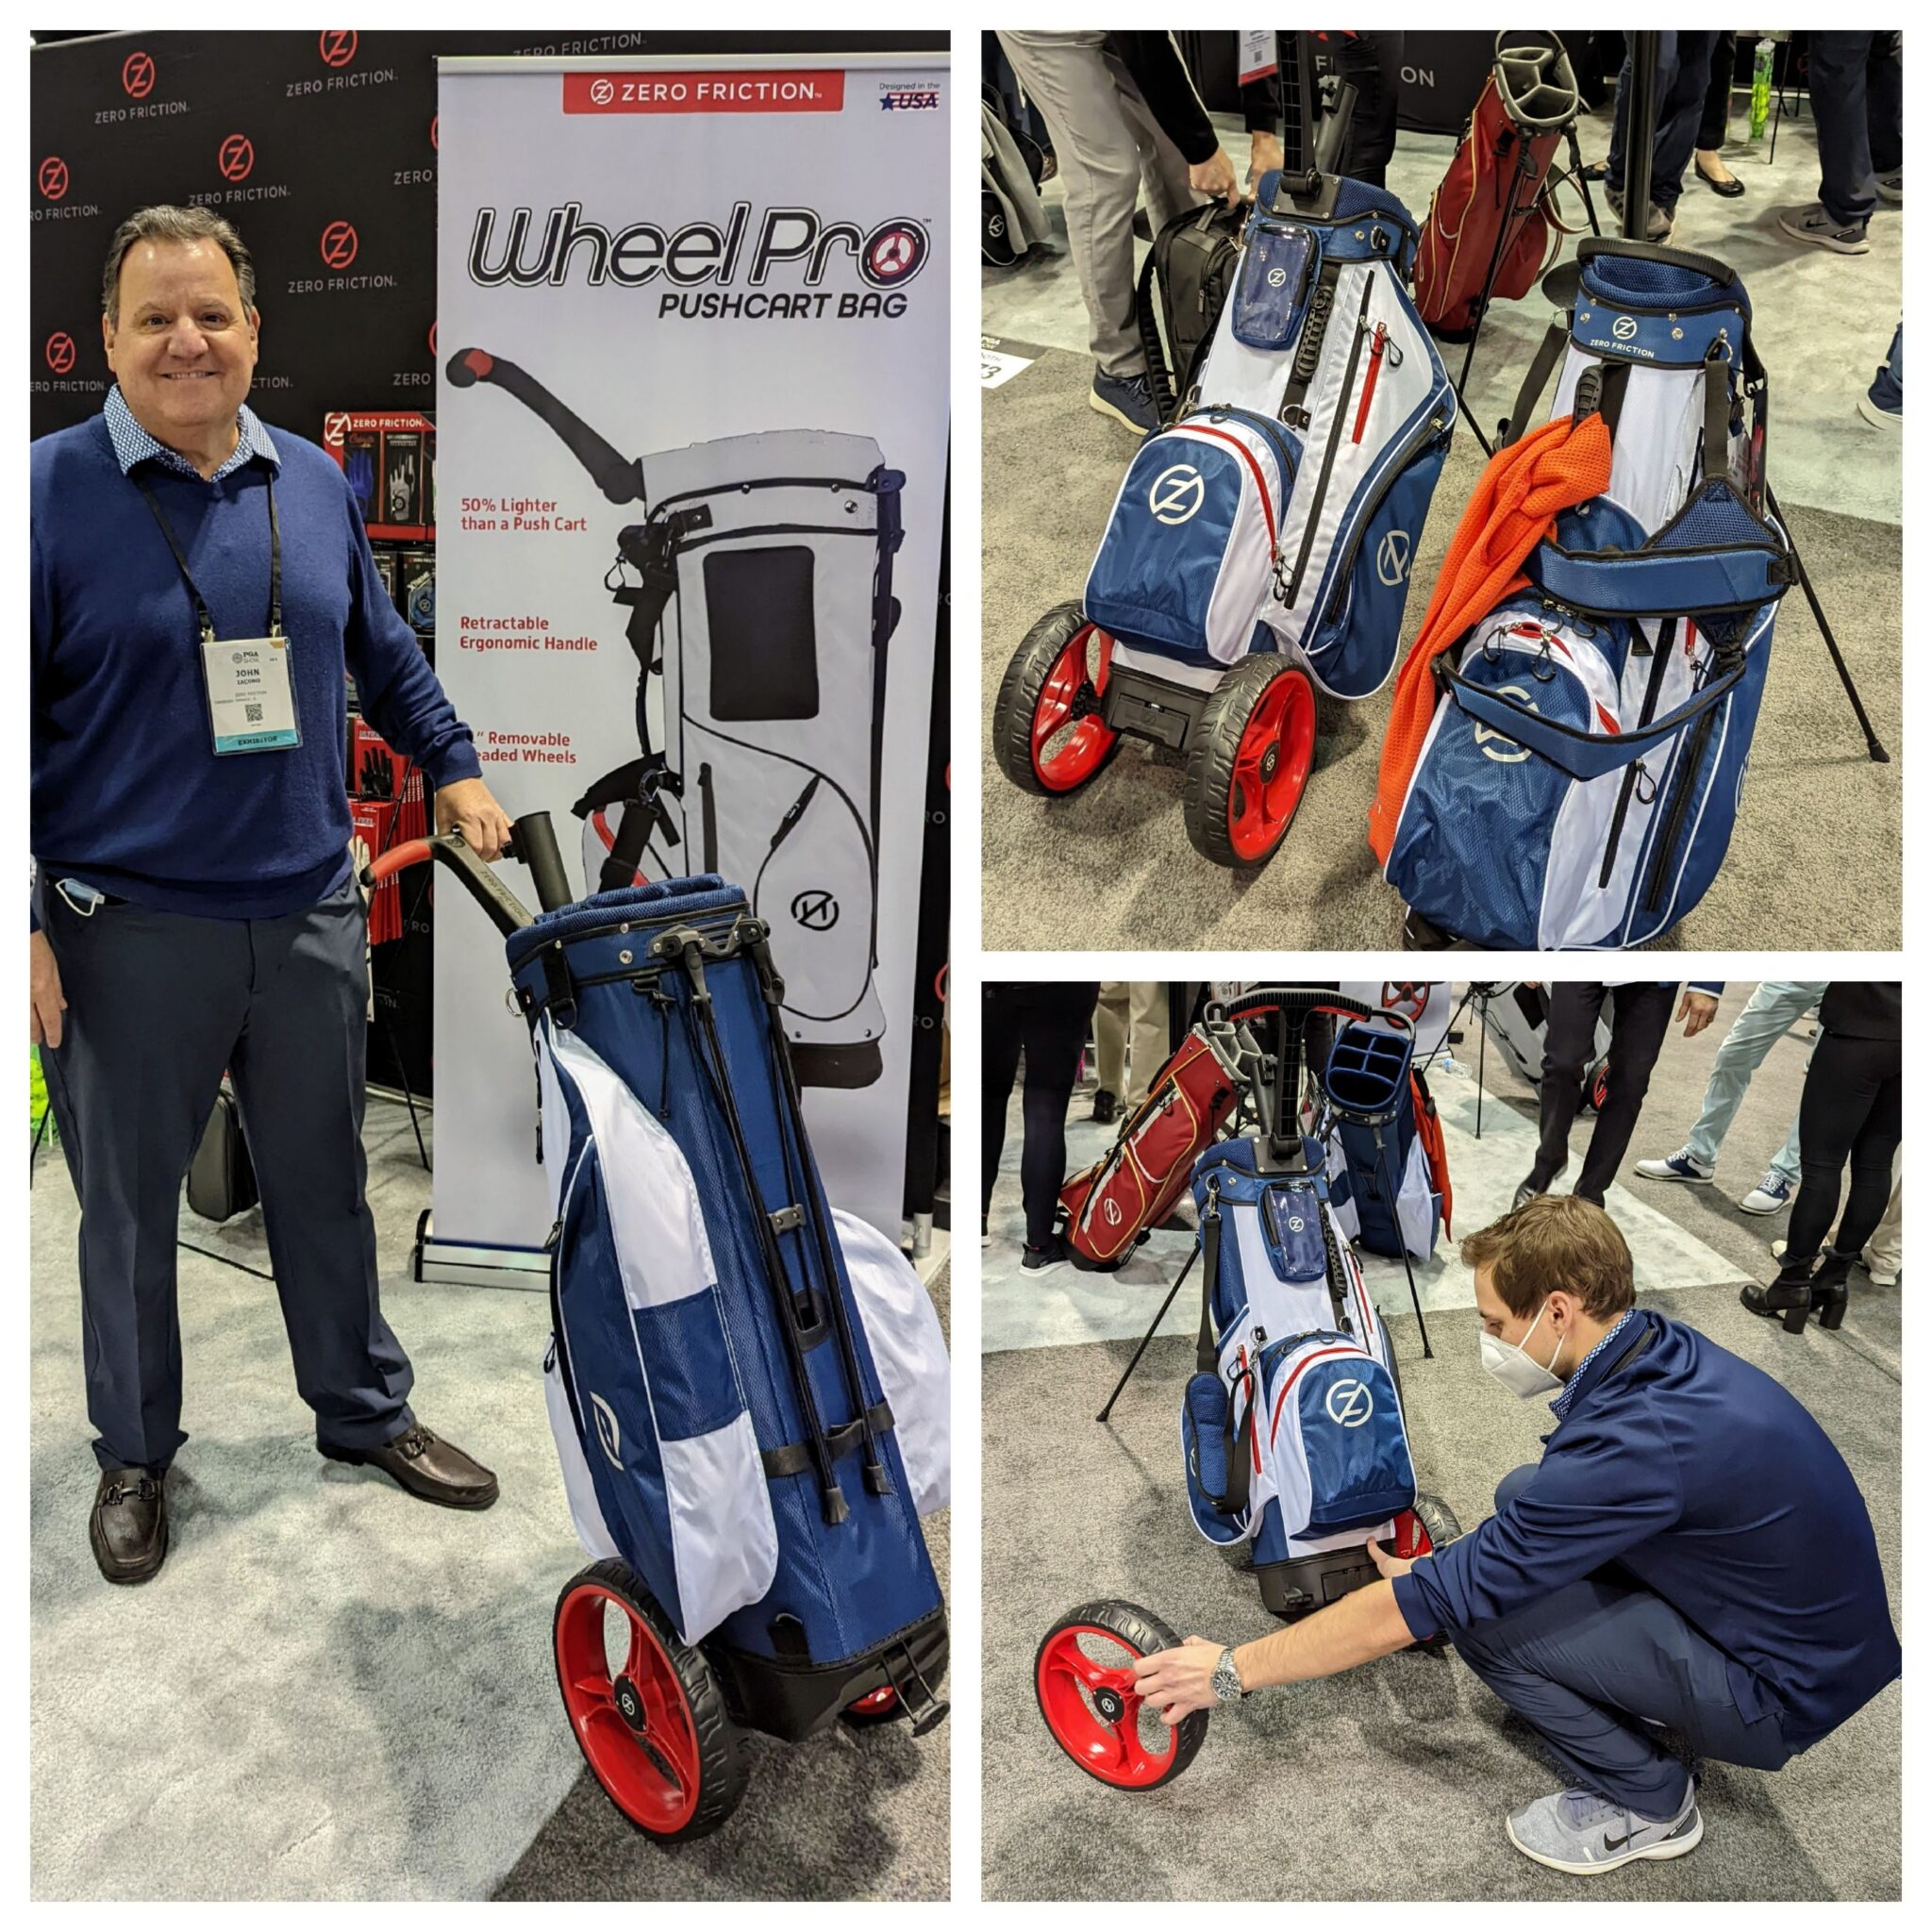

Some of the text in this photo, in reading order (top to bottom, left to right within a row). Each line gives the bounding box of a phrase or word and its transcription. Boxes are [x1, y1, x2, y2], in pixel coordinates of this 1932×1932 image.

[286, 69, 394, 97] ZERO FRICTION
[879, 82, 916, 91] Designed
[621, 83, 687, 102] ZERO
[899, 92, 938, 109] USA
[95, 101, 188, 125] ZERO FRICTION
[393, 169, 433, 185] ZERO
[189, 185, 287, 207] ZERO FRICTION
[45, 205, 99, 220] FRICTION
[468, 202, 751, 287] Wheel
[288, 275, 393, 293] ZERO FRICTION
[658, 293, 908, 318] PUSHCART BAG
[1590, 339, 1655, 358] ZERO FRICTION
[53, 380, 105, 392] FRICTION
[392, 373, 431, 386] ZERO
[353, 419, 377, 427] ZERO
[378, 419, 423, 427] FRICTION
[461, 497, 558, 516] 50% Lighter
[460, 516, 587, 531] than a Push Cart
[460, 615, 549, 630] Retractable
[459, 636, 598, 653] Ergonomic Handle
[236, 669, 259, 677] JOHN
[238, 736, 277, 745] EXHIBITOR
[488, 731, 571, 746] Removable
[522, 749, 576, 763] Wheels
